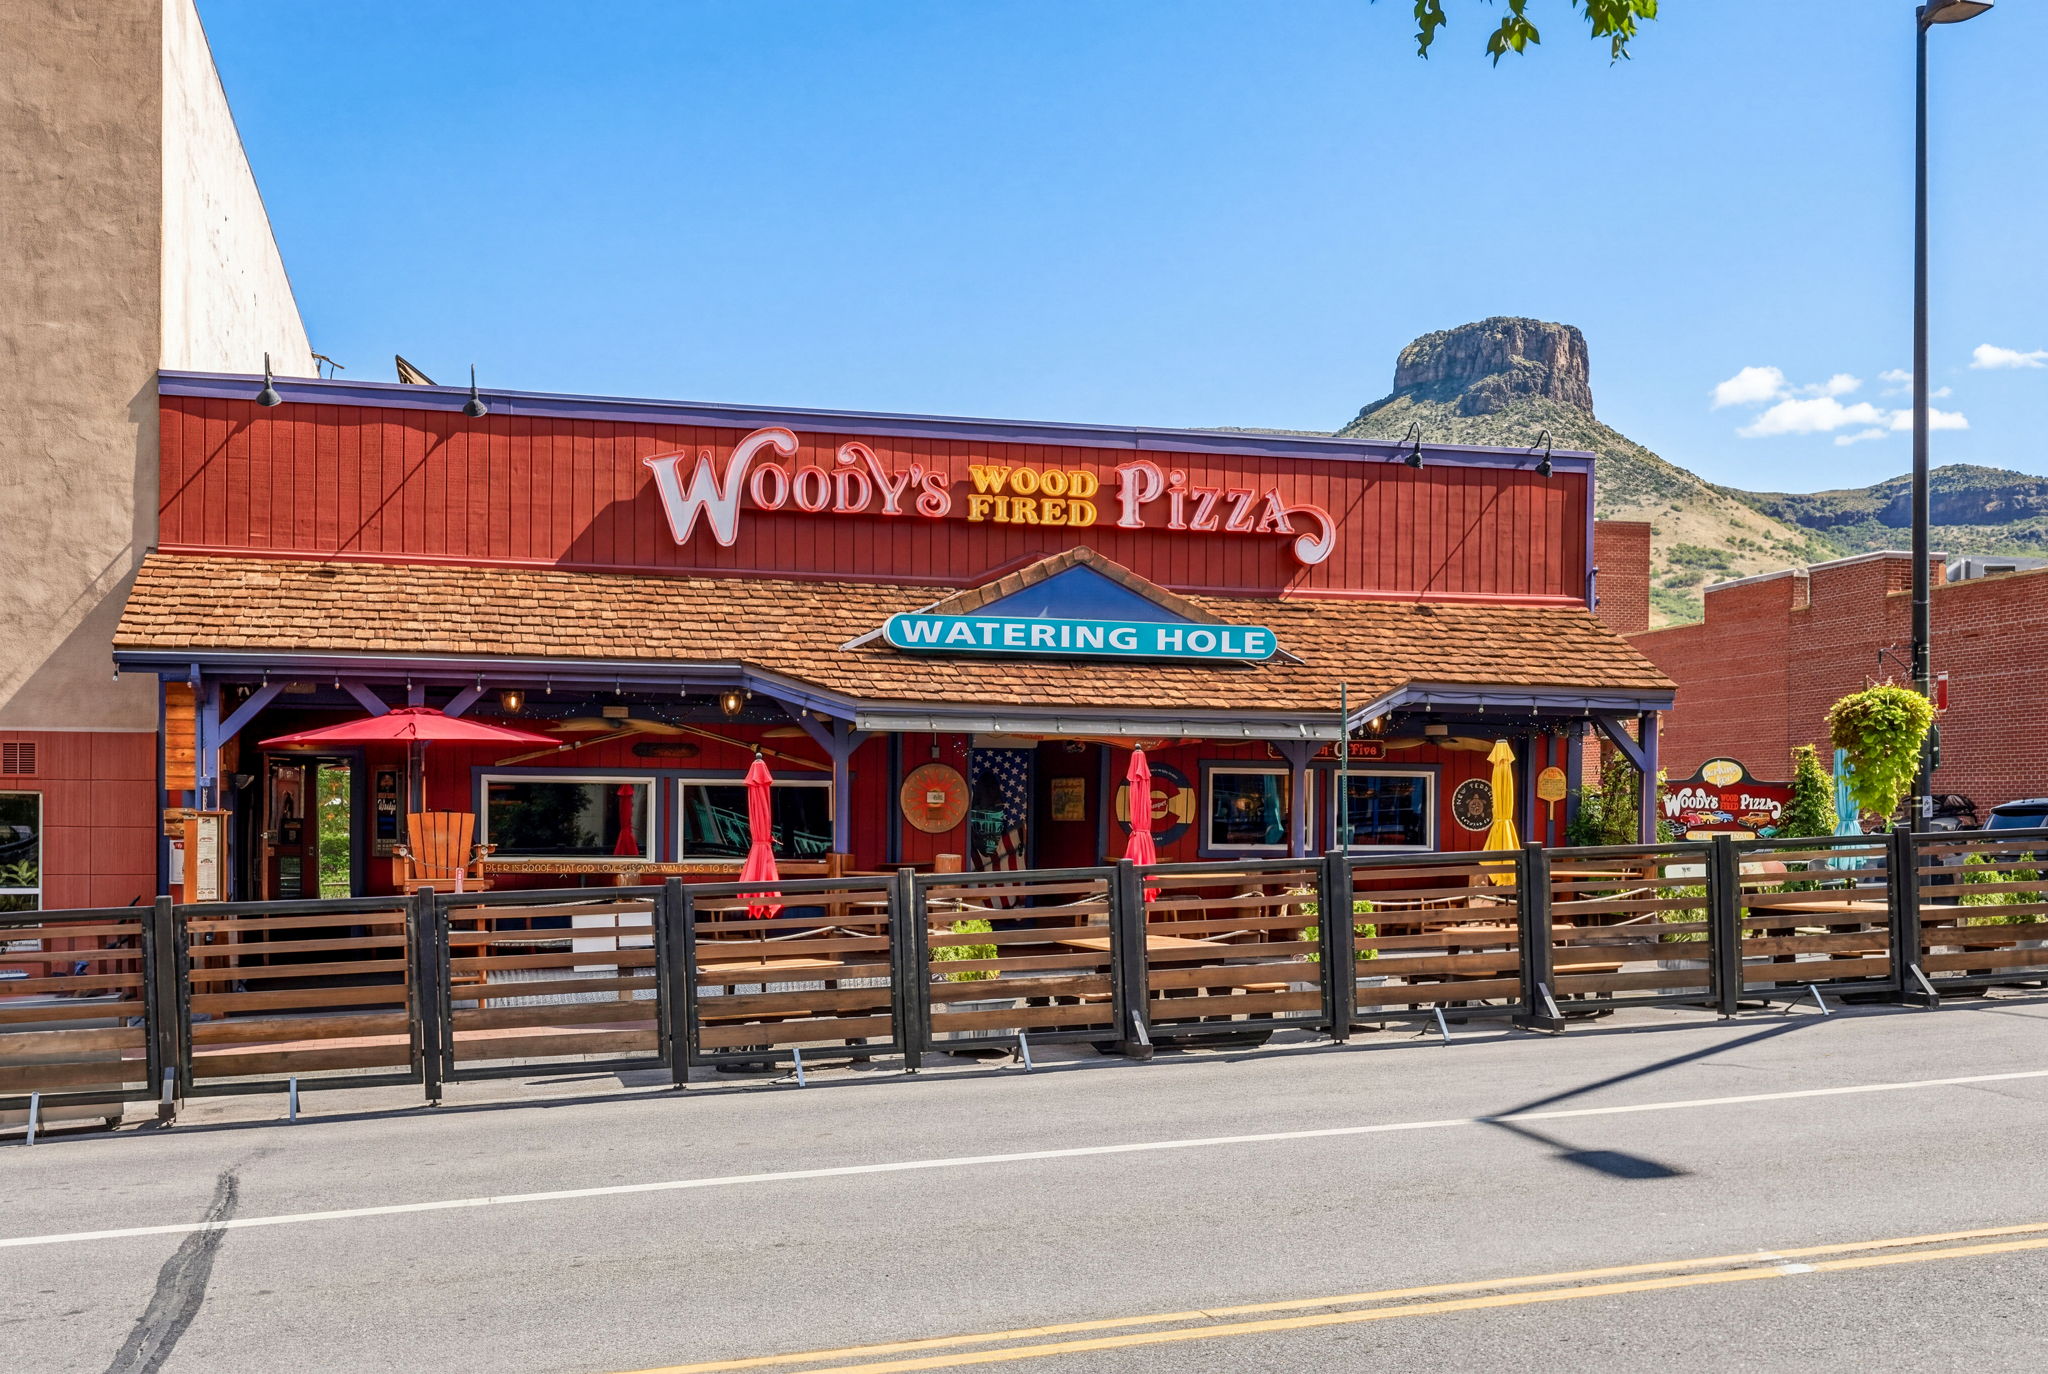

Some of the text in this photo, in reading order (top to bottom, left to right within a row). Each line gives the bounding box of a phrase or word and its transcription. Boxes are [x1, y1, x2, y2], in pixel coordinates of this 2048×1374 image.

[968, 465, 1099, 499] WOOD
[967, 494, 1098, 527] FIRED
[900, 619, 1267, 654] WATERING HOLE
[1662, 787, 1718, 817] WOODY'S
[1720, 793, 1739, 802] WOOD
[555, 863, 576, 873] THAT
[576, 863, 595, 873] GOD
[660, 863, 690, 873] WANTS
[693, 863, 705, 873] US
[709, 863, 720, 873] TO
